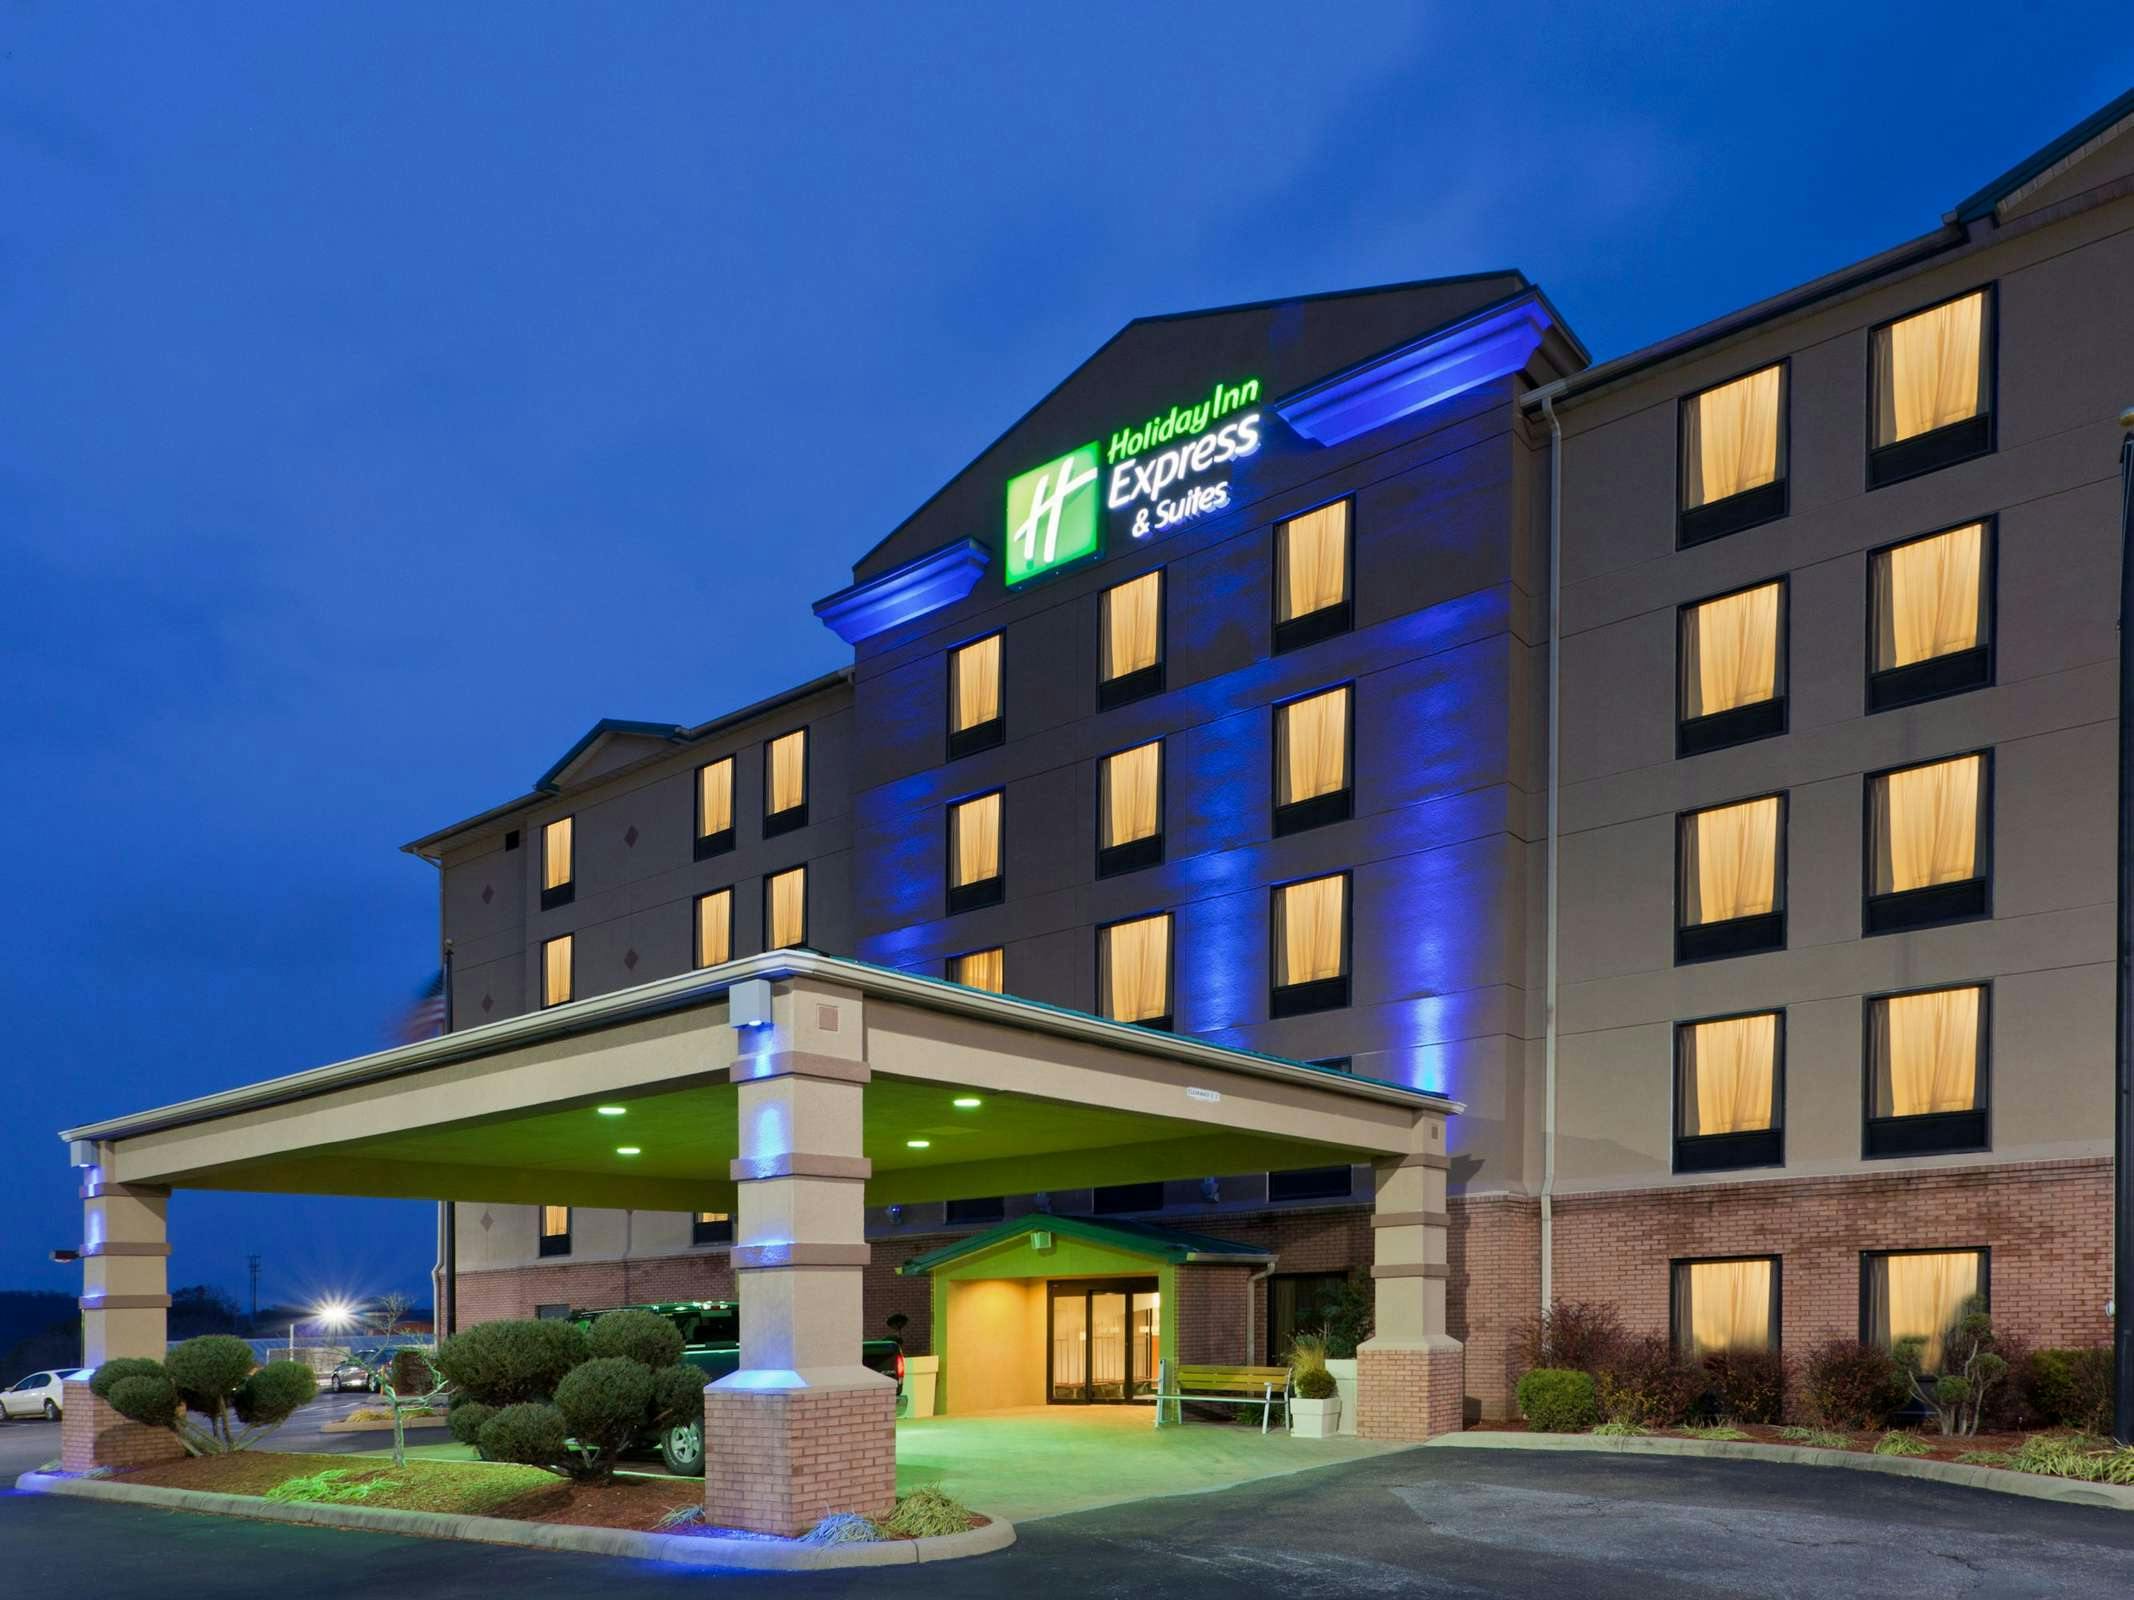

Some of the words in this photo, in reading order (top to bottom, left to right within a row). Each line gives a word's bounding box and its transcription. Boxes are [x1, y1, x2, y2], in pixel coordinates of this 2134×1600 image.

[1108, 402, 1210, 464] Holiday
[1211, 379, 1259, 419] Inn
[1108, 413, 1262, 508] Express
[1131, 508, 1150, 538] &
[1154, 481, 1230, 529] Suites
